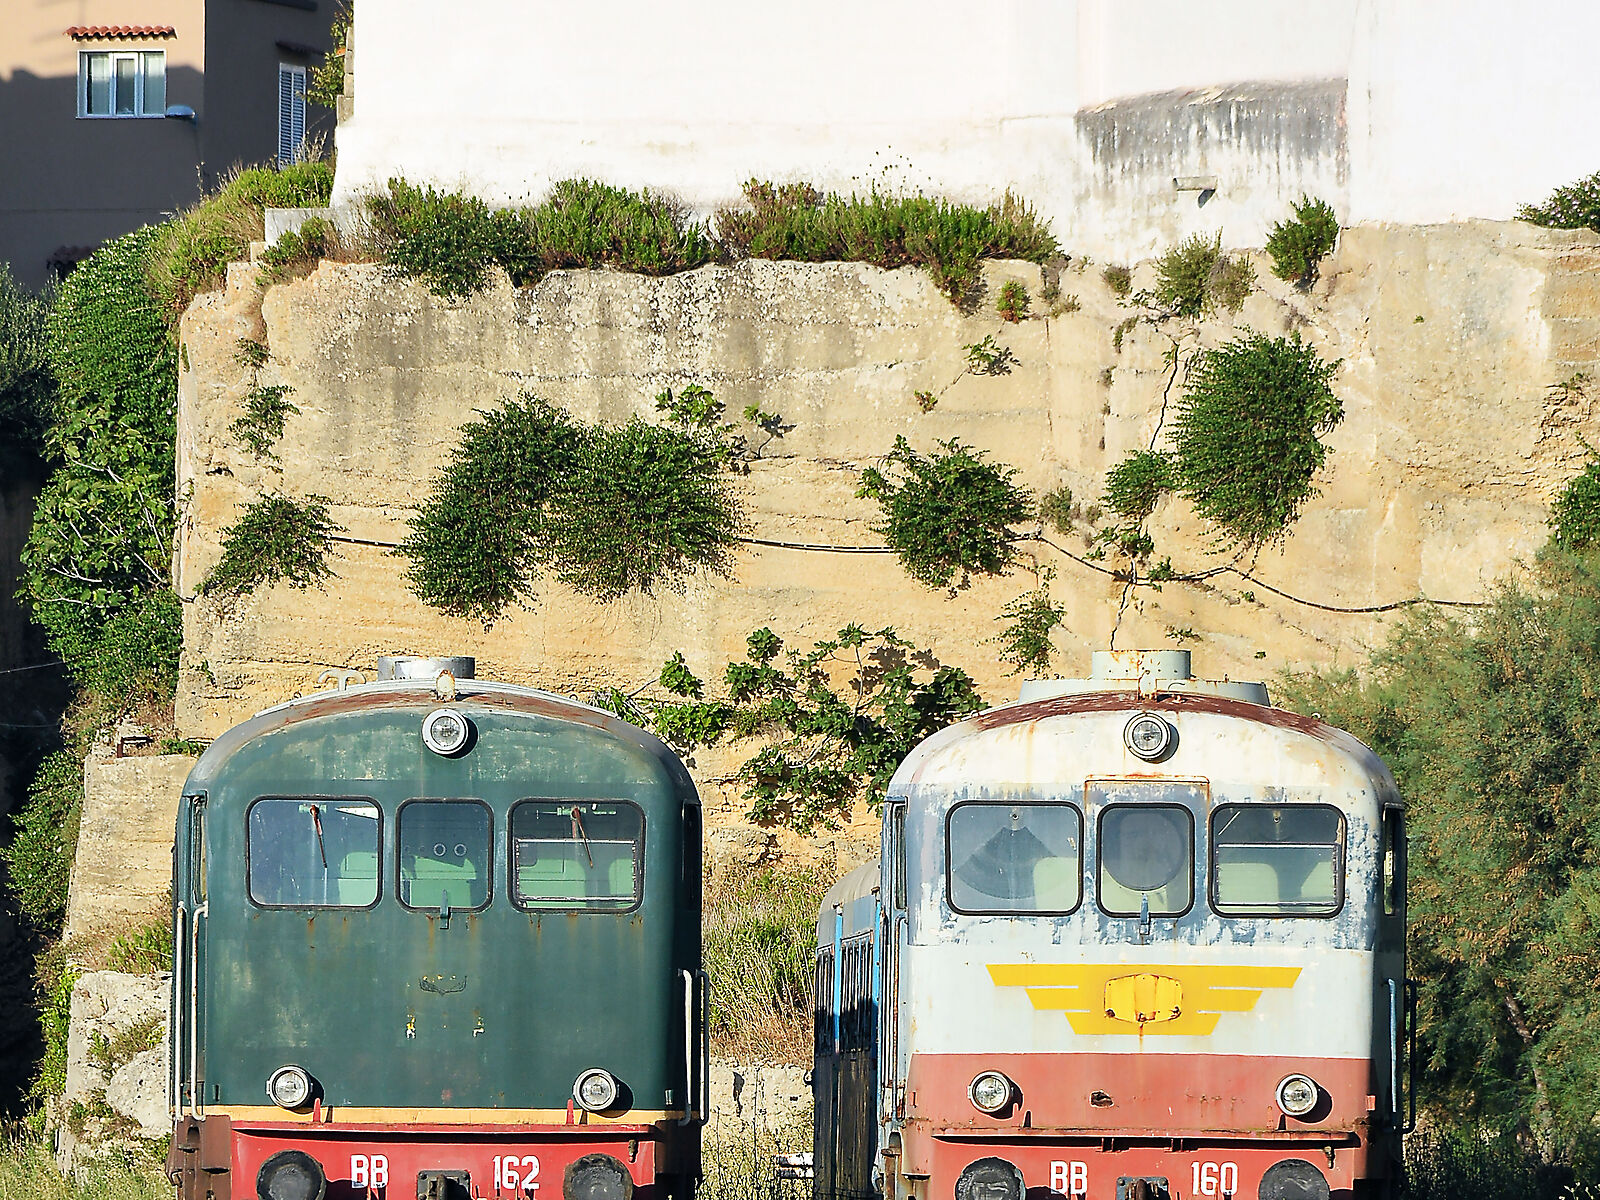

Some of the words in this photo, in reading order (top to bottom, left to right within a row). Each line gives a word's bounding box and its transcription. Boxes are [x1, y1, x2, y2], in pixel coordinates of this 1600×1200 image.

[350, 1154, 389, 1189] BB
[492, 1154, 541, 1190] 162
[1049, 1160, 1089, 1195] BB
[1190, 1161, 1239, 1196] 160
